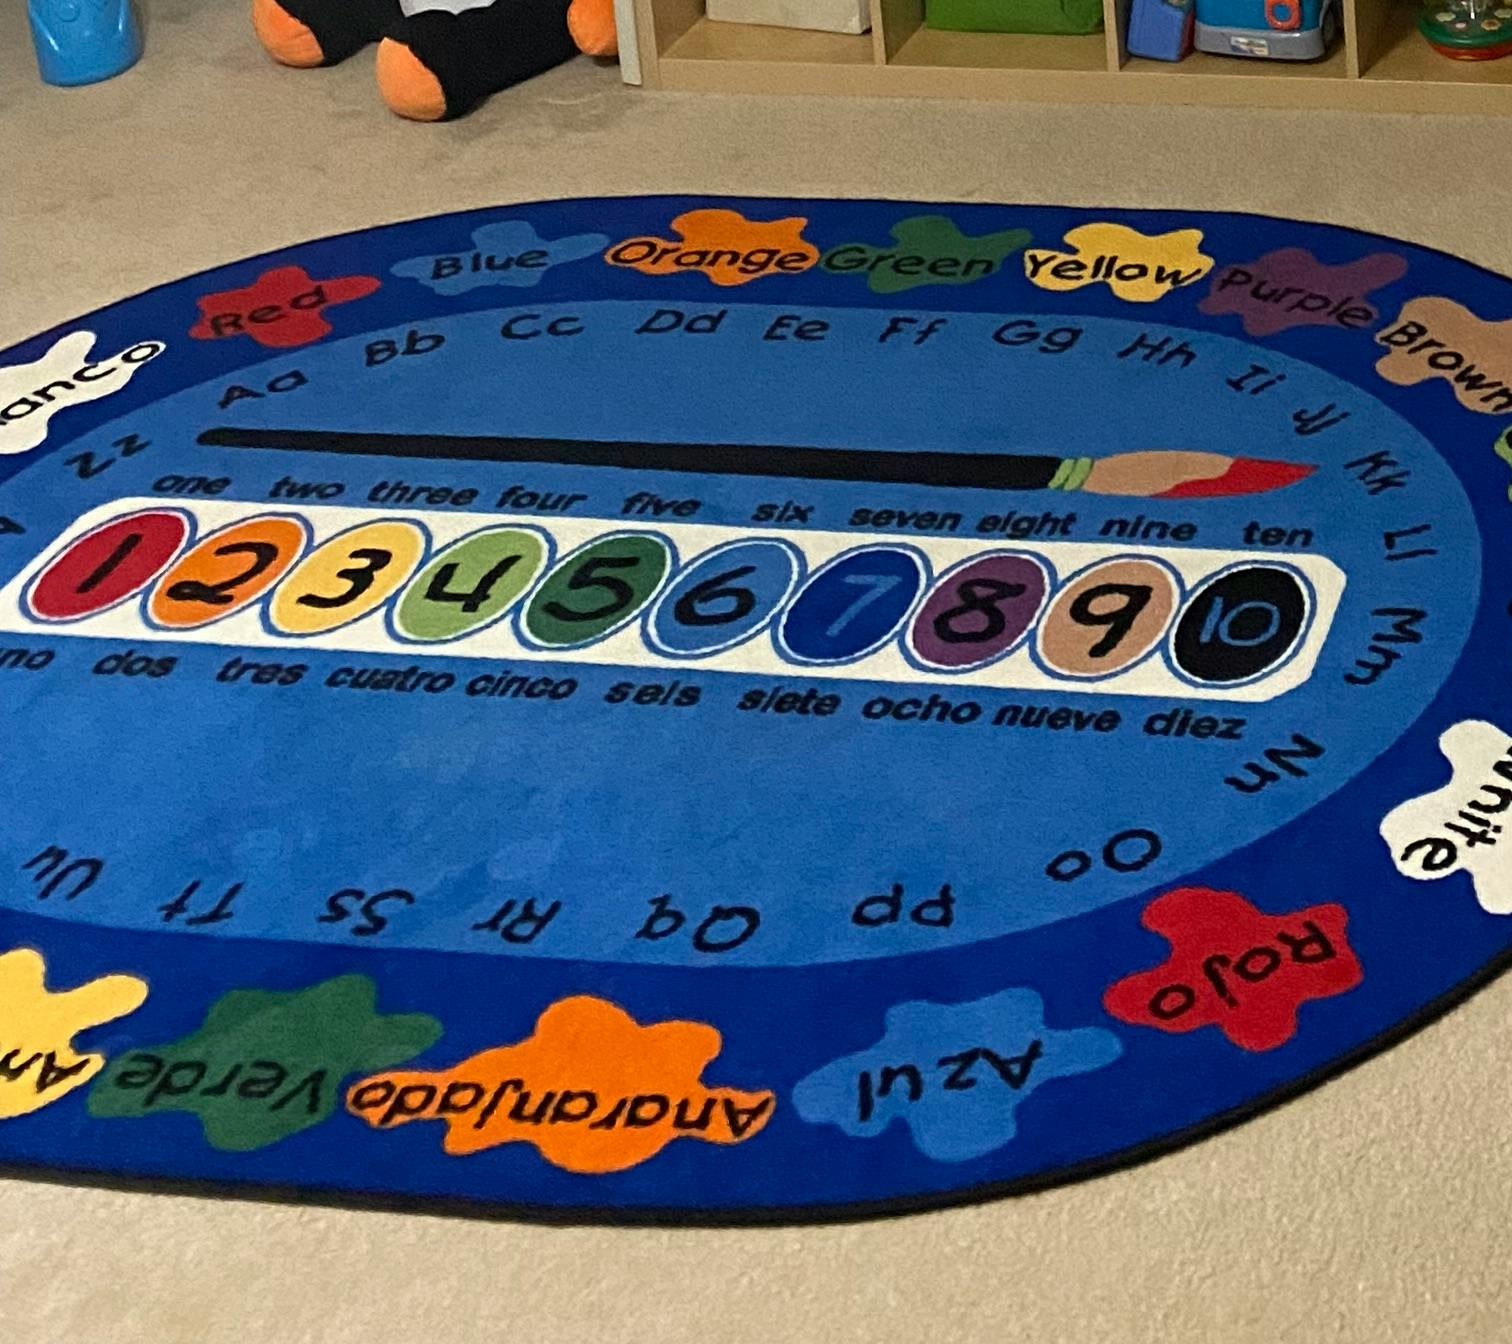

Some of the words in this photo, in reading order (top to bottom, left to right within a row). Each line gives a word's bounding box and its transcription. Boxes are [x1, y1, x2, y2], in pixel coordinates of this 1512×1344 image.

[430, 249, 549, 280] Blue
[611, 240, 809, 274] Orange
[824, 246, 995, 277] Green
[1027, 254, 1202, 286] Yellow
[210, 284, 328, 337] Red
[501, 314, 584, 340] Cc
[635, 309, 728, 335] Dd
[763, 314, 830, 341] Ee
[879, 317, 948, 345] Ff
[365, 329, 445, 367] Bb
[992, 319, 1084, 353] Gg
[1117, 332, 1197, 369] Hh
[0, 343, 160, 426] anco
[217, 370, 308, 410] Aa
[1226, 363, 1287, 395] Ii
[1293, 403, 1350, 436] Jj
[64, 433, 152, 479] Zz
[1344, 450, 1411, 496] Kk
[152, 473, 231, 497] one
[269, 476, 345, 499] two
[367, 480, 479, 506] three
[496, 485, 588, 511] four
[621, 490, 702, 516] five
[750, 500, 815, 524] six
[848, 507, 961, 532] seven
[976, 511, 1078, 540] eight
[1100, 514, 1199, 542] nine
[1242, 519, 1315, 547] ten
[1384, 523, 1438, 561] Ll
[76, 533, 142, 594] 1
[166, 541, 279, 604] 2
[296, 548, 393, 608] 3
[425, 554, 523, 613] 4
[541, 556, 641, 622] 5
[673, 565, 757, 626] 6
[826, 574, 902, 637] 7
[932, 578, 1027, 644] 8
[1069, 583, 1154, 659] 9
[1200, 596, 1281, 647] 10
[1343, 607, 1428, 685] Mm
[0, 647, 56, 670] no
[92, 649, 179, 678] dos
[216, 656, 309, 685] tres
[325, 665, 456, 694] cuatro
[464, 671, 578, 700] cinco
[603, 680, 702, 707] seis
[737, 687, 843, 716] siete
[862, 694, 982, 727] ocho
[993, 703, 1123, 733] nueve
[1144, 707, 1249, 740] diez
[1224, 733, 1326, 795] Nn
[22, 845, 104, 900] Uu
[1045, 828, 1163, 881] Oo
[158, 880, 246, 925] Tt
[316, 888, 415, 937] Ss
[471, 897, 562, 944] Rr
[635, 894, 761, 953] Qq
[851, 883, 956, 927] Pp
[1147, 920, 1336, 1020] Rojo
[114, 1053, 328, 1113] Verde
[858, 1040, 1045, 1122] Azul
[351, 1079, 773, 1138] Anaranjado
